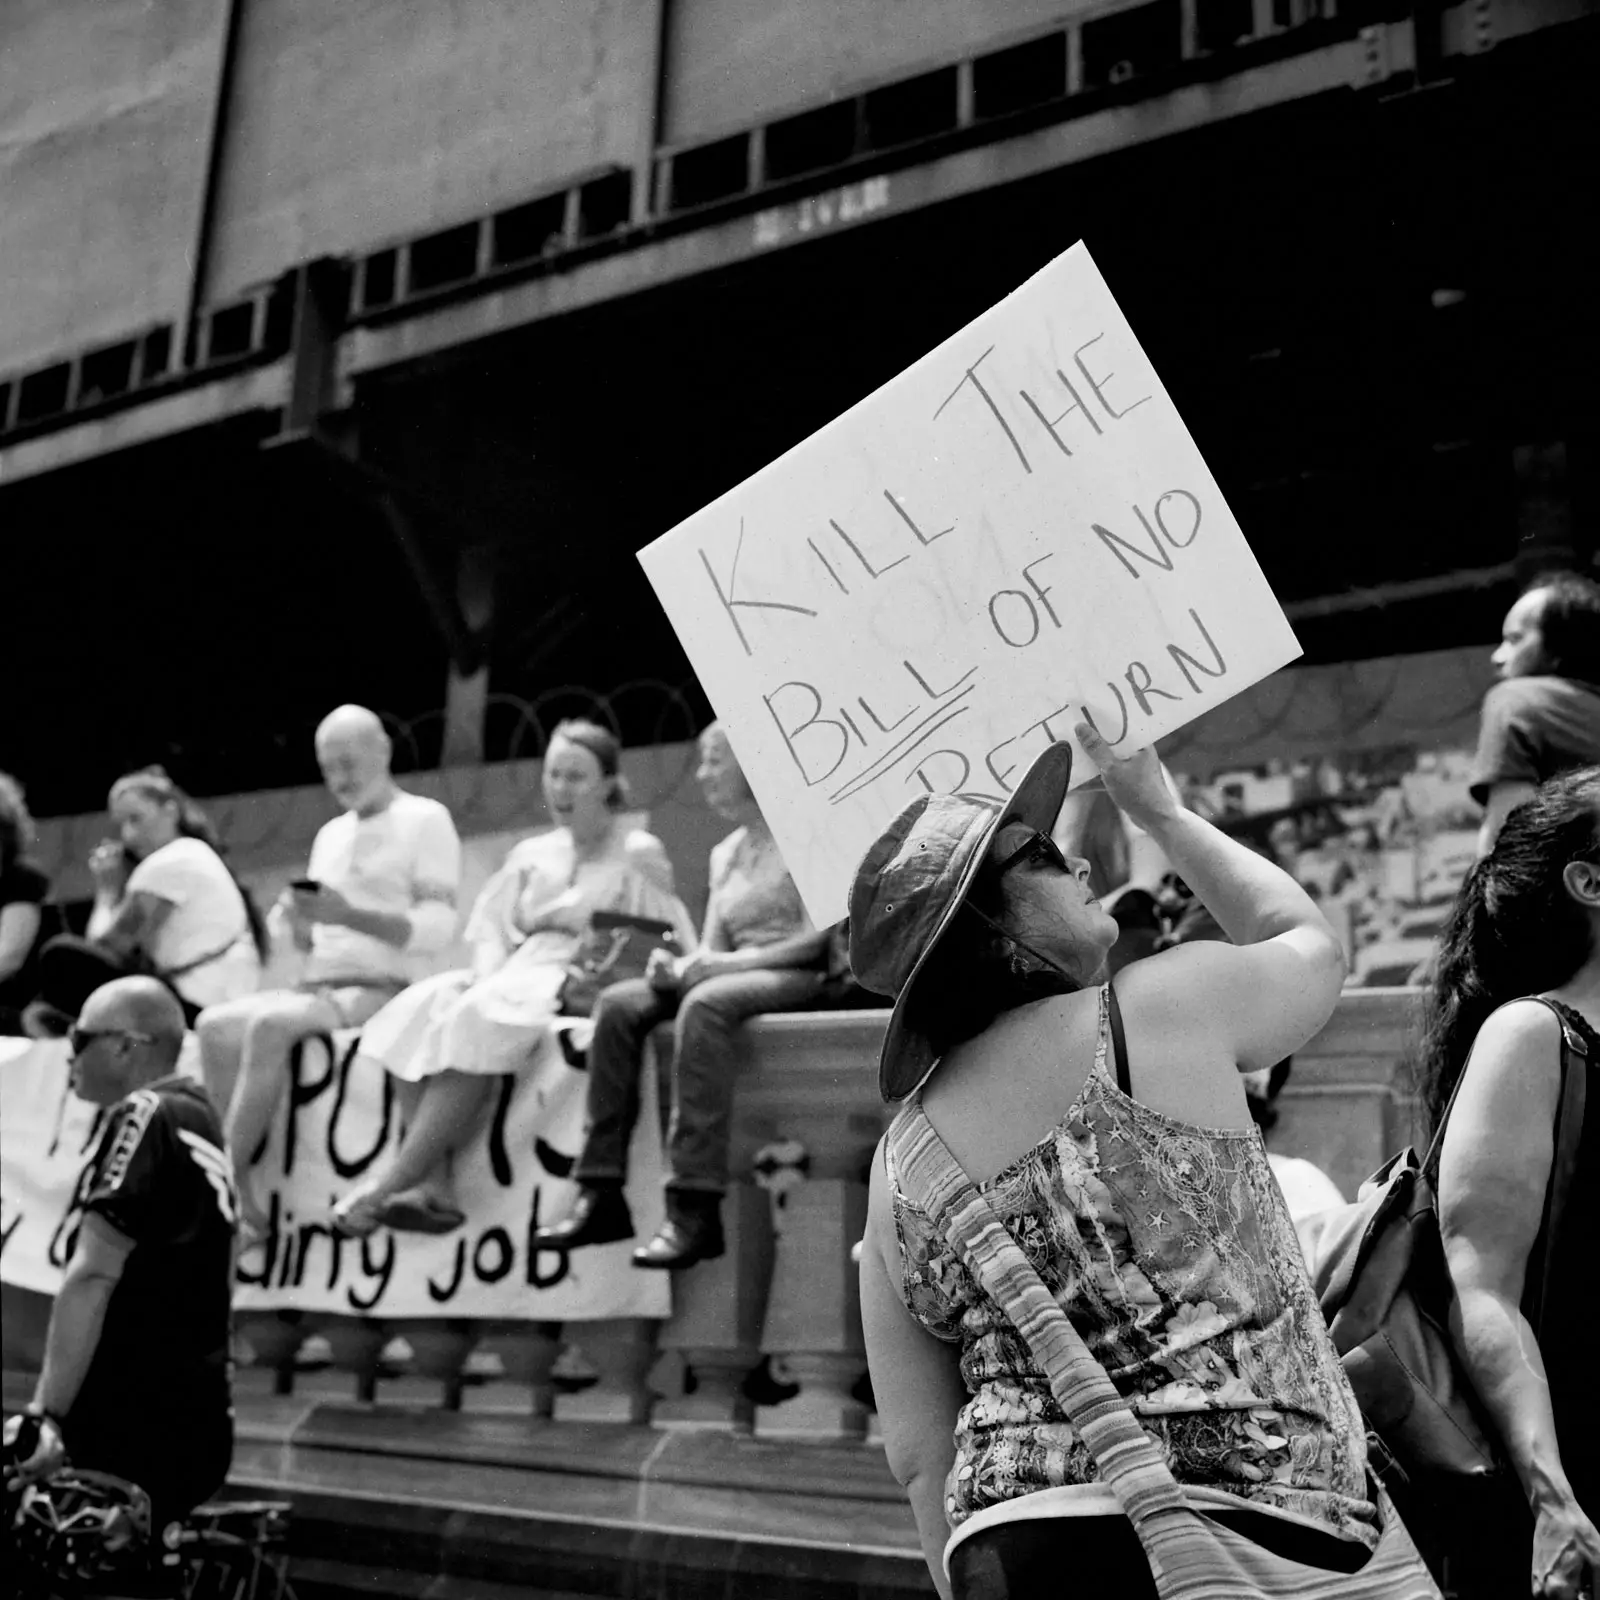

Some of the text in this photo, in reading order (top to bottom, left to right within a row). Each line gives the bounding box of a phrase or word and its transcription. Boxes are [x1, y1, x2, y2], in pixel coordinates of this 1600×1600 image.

[698, 330, 1153, 657] KILL THE
[761, 487, 1202, 787] BILL OF NO
[427, 1182, 571, 1303] job
